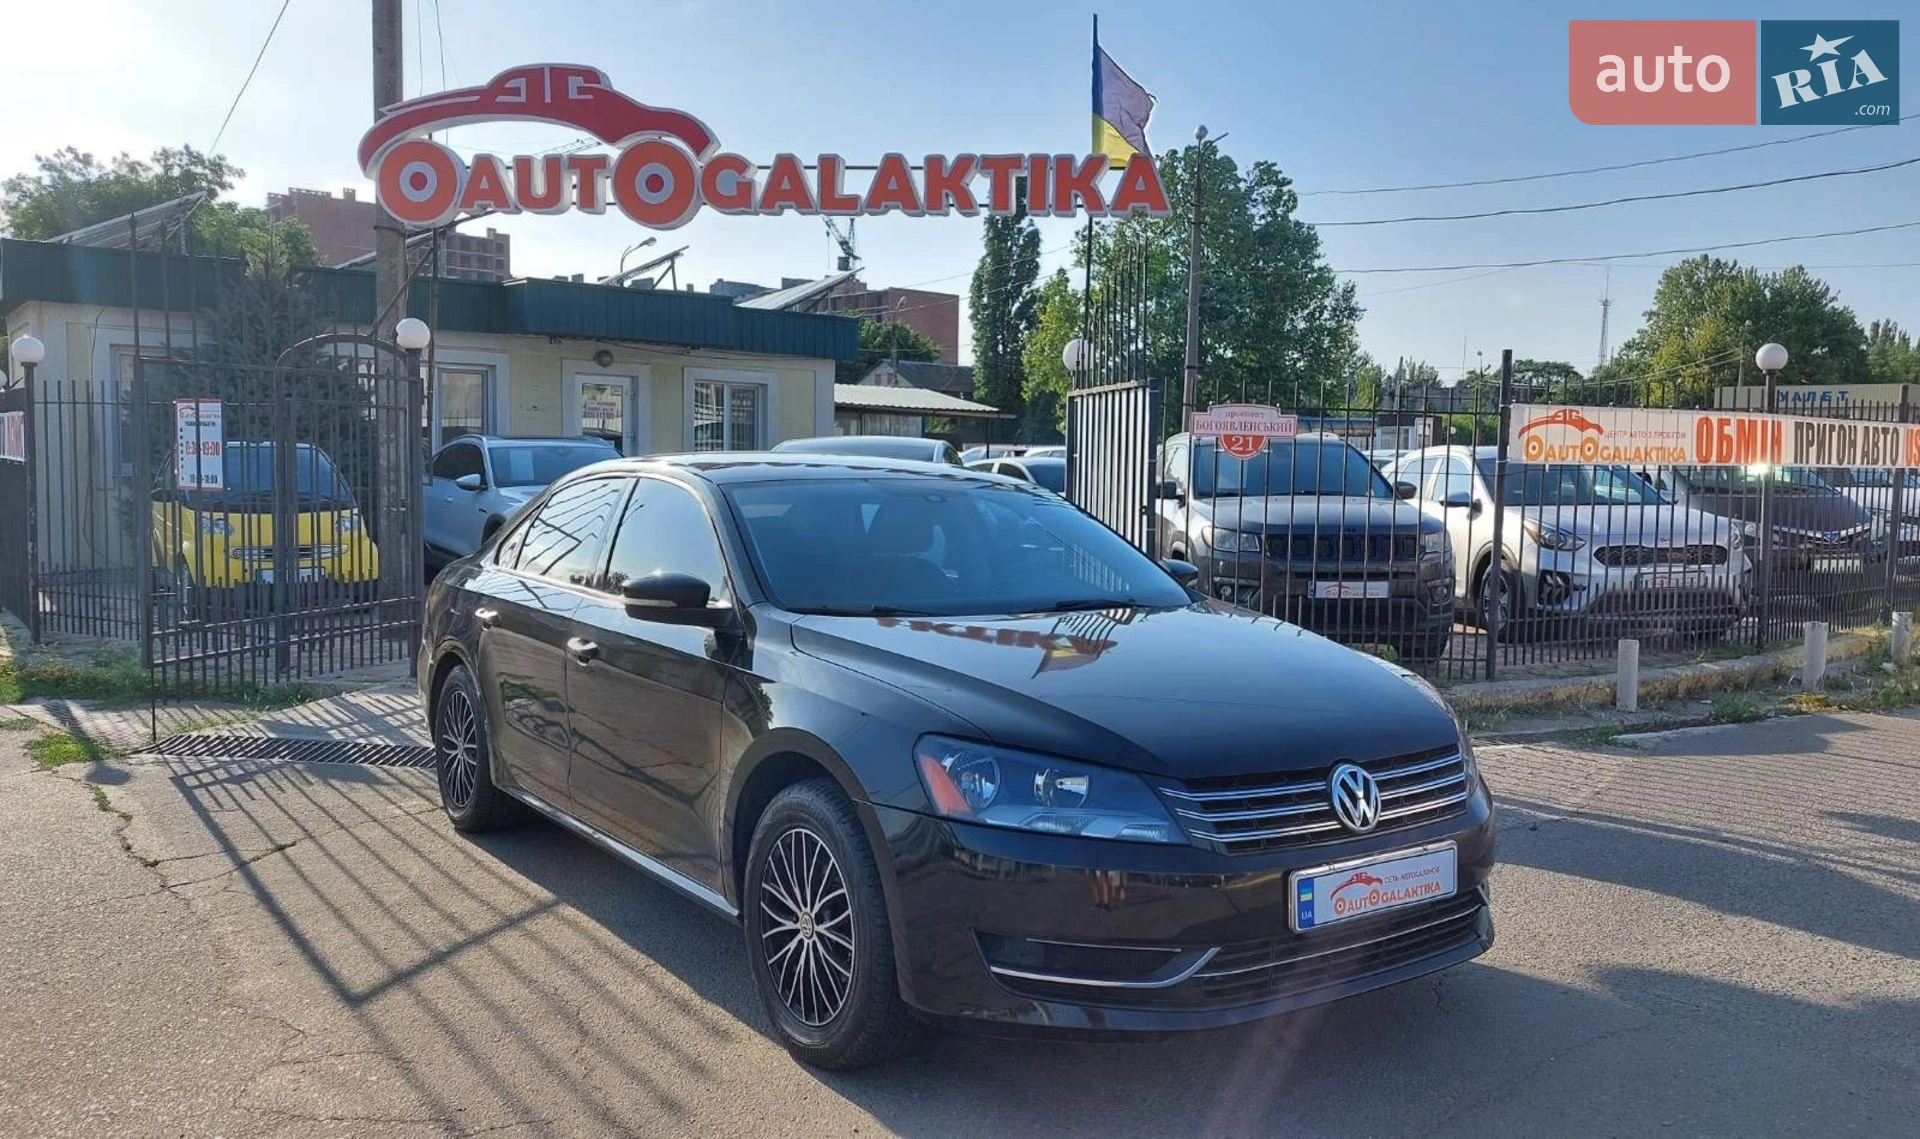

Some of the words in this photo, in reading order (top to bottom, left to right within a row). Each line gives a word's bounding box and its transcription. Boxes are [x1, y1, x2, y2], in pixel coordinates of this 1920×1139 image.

[1195, 420, 1292, 433] БОГОЯВЛЕНСЬКИЙ
[1230, 435, 1255, 451] 21
[1696, 416, 1783, 464] ОБМІН
[1793, 421, 1858, 466] ПРИГОН
[1861, 425, 1900, 466] АВТО
[1301, 911, 1313, 920] UA
